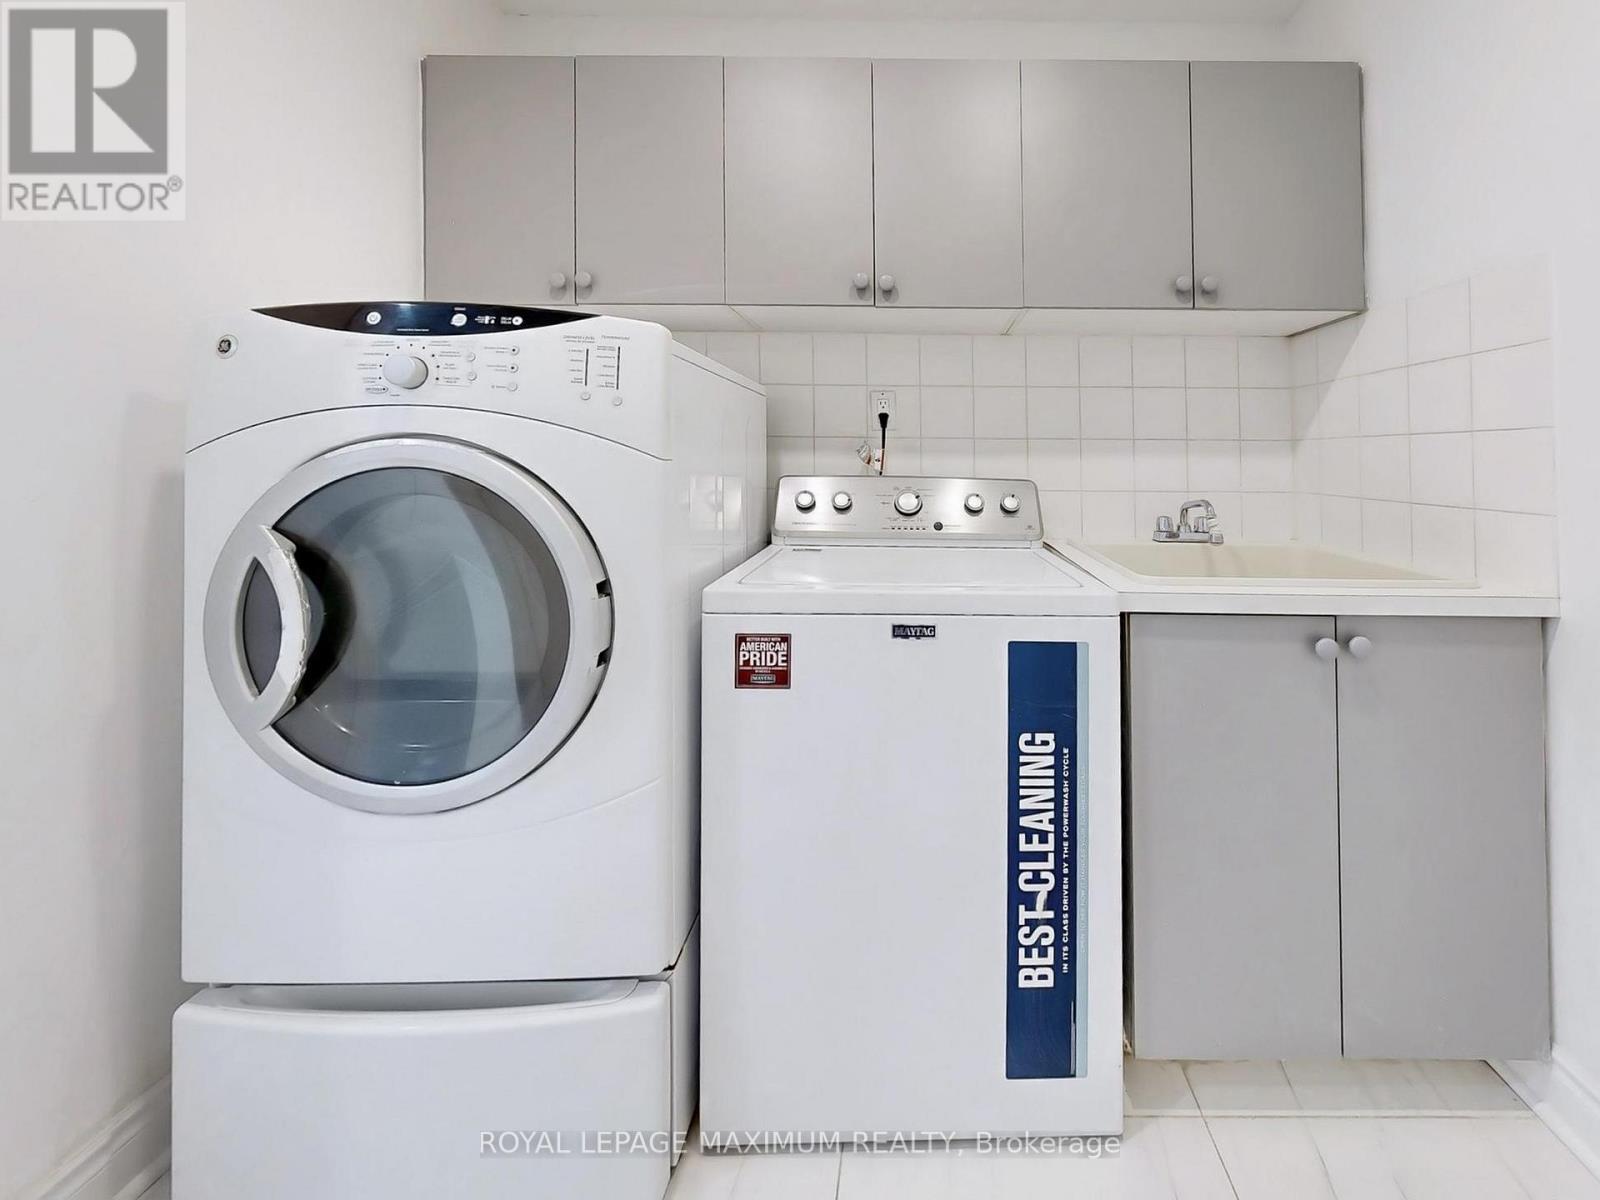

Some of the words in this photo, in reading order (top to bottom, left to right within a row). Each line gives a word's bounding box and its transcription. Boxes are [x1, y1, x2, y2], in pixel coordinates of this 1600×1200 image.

[894, 627, 935, 636] MAYTAG
[740, 642, 788, 651] AMERICAN
[739, 651, 788, 666] PRIDE
[1062, 747, 1070, 777] CYCLE
[1017, 732, 1056, 892] CLEANING
[1062, 862, 1069, 874] BY
[1017, 904, 1056, 989] BEST
[1062, 963, 1069, 973] IN
